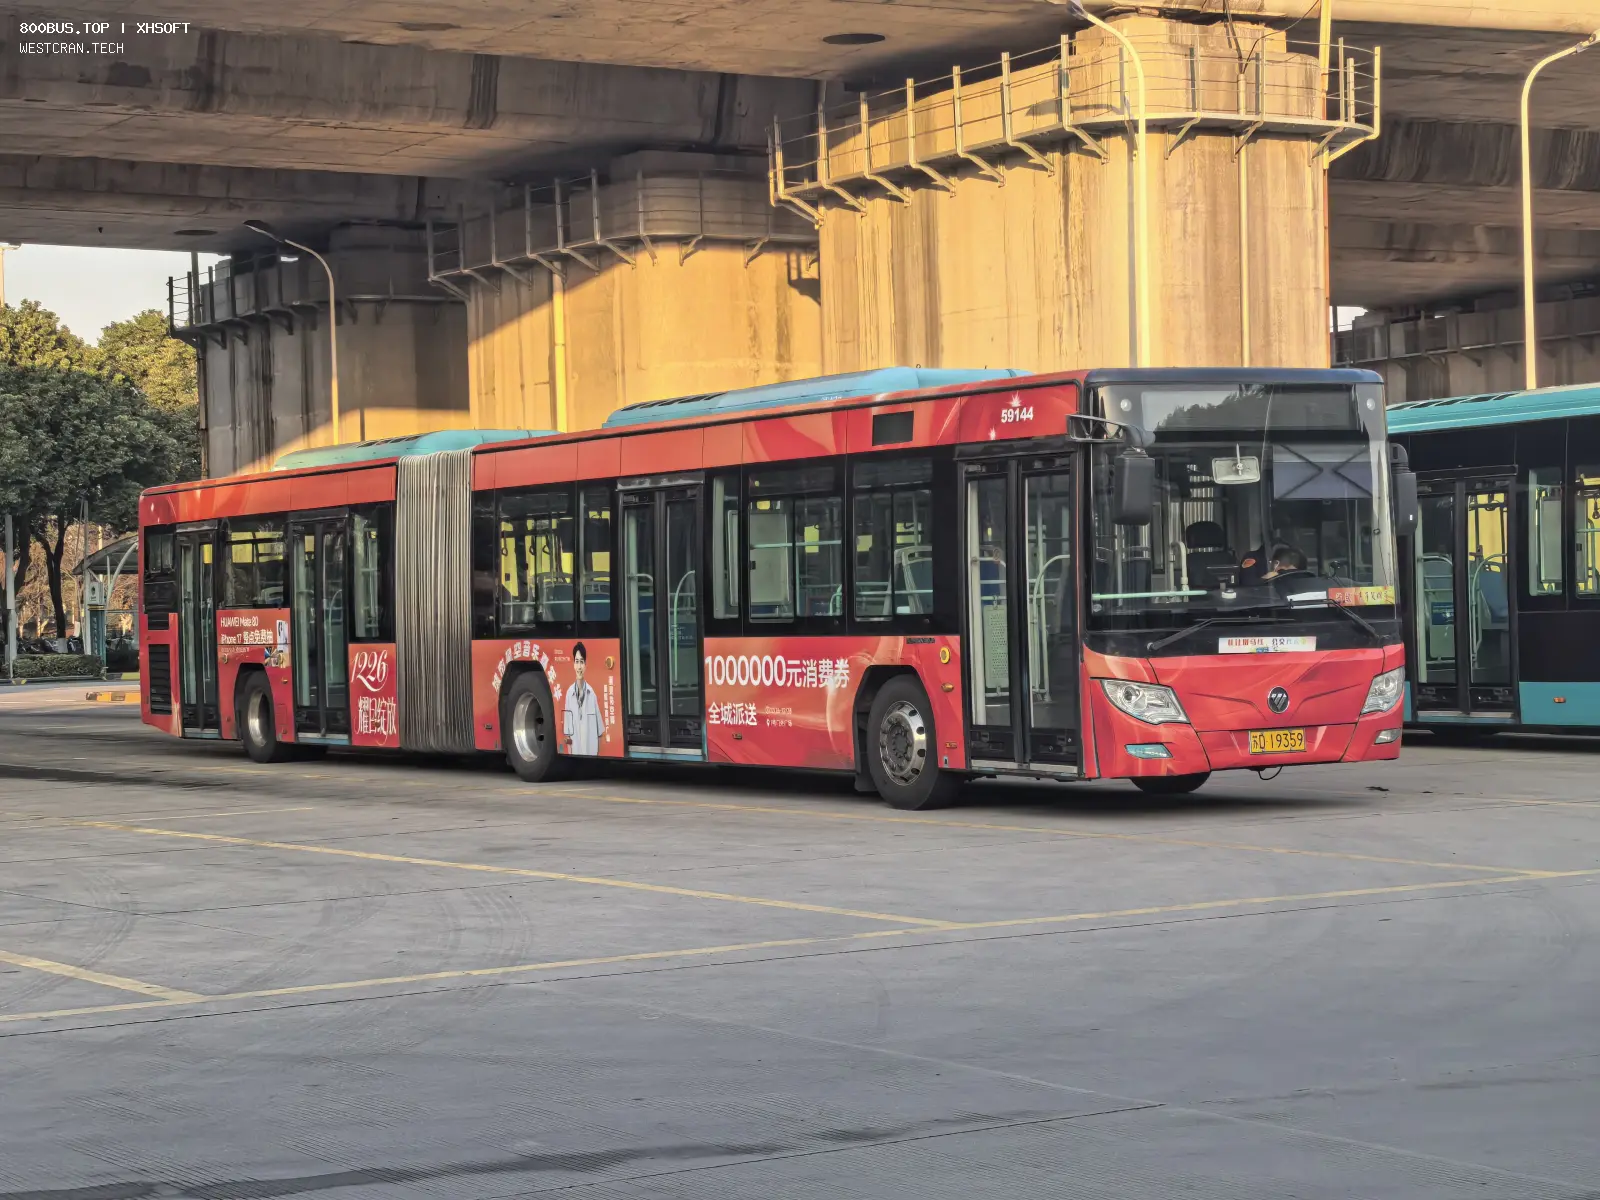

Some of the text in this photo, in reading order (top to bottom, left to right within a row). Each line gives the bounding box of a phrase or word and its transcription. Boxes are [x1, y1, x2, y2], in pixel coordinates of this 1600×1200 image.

[1001, 406, 1034, 424] 59144
[351, 649, 389, 692] 1226
[704, 655, 850, 689] 1000000元消费券
[707, 701, 758, 727] 全城派送
